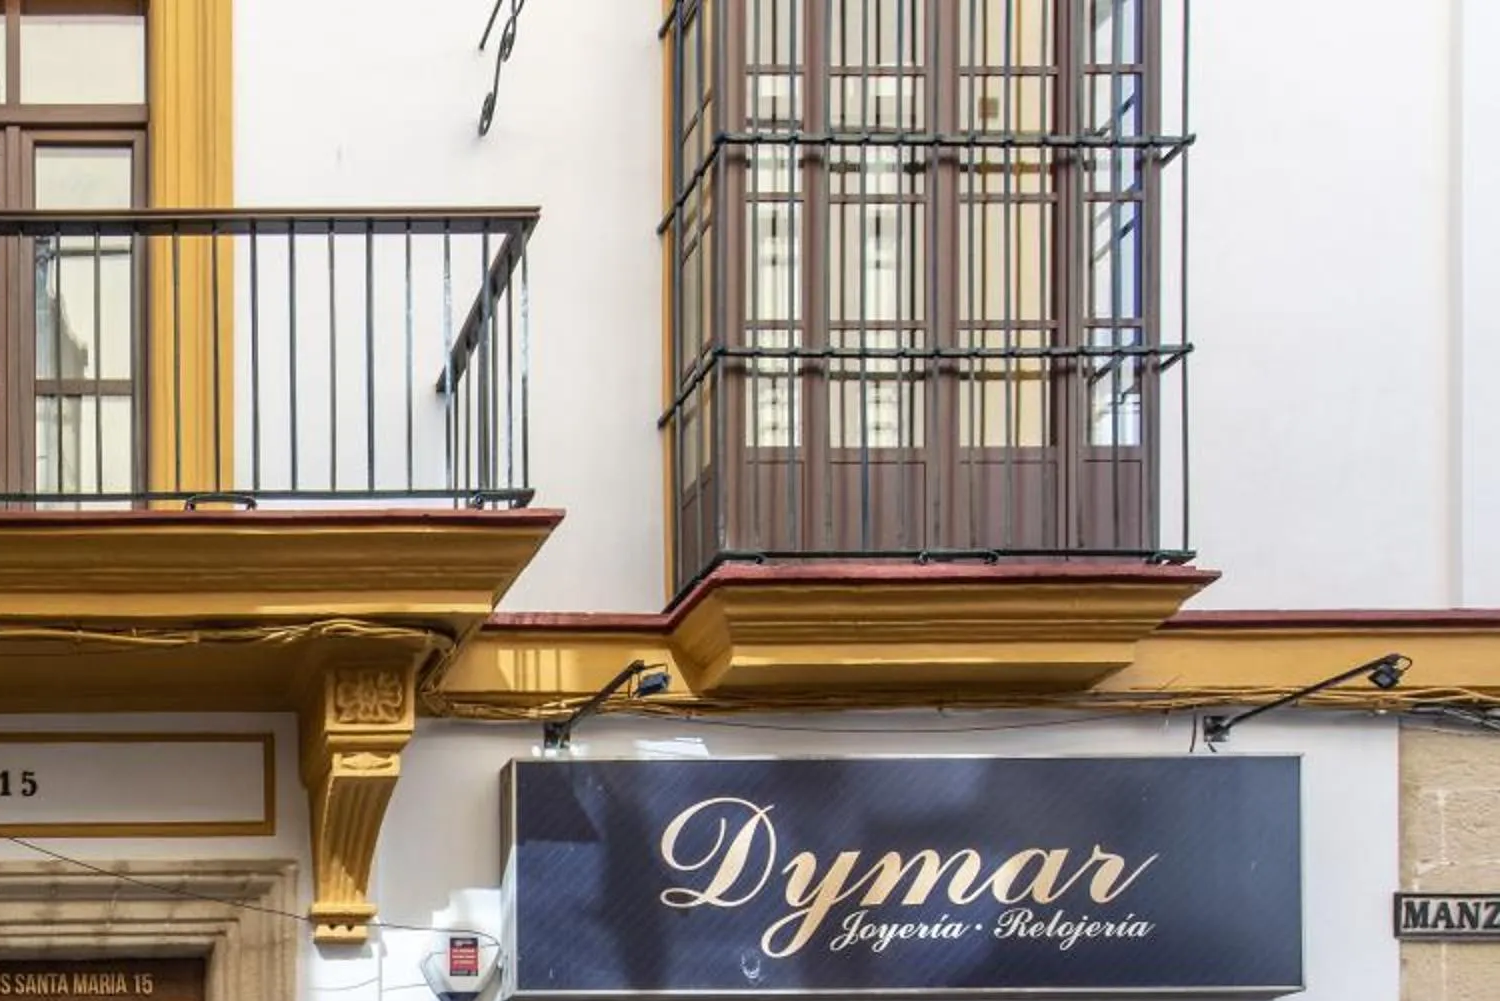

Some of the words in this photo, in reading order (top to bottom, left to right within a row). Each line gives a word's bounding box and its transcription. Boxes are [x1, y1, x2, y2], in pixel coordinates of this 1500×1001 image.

[660, 797, 1158, 958] Dymar
[830, 909, 970, 952] Joyería
[994, 907, 1155, 950] Relojería
[15, 972, 69, 995] SANTA
[73, 972, 128, 995] MARIA
[133, 973, 154, 994] 15
